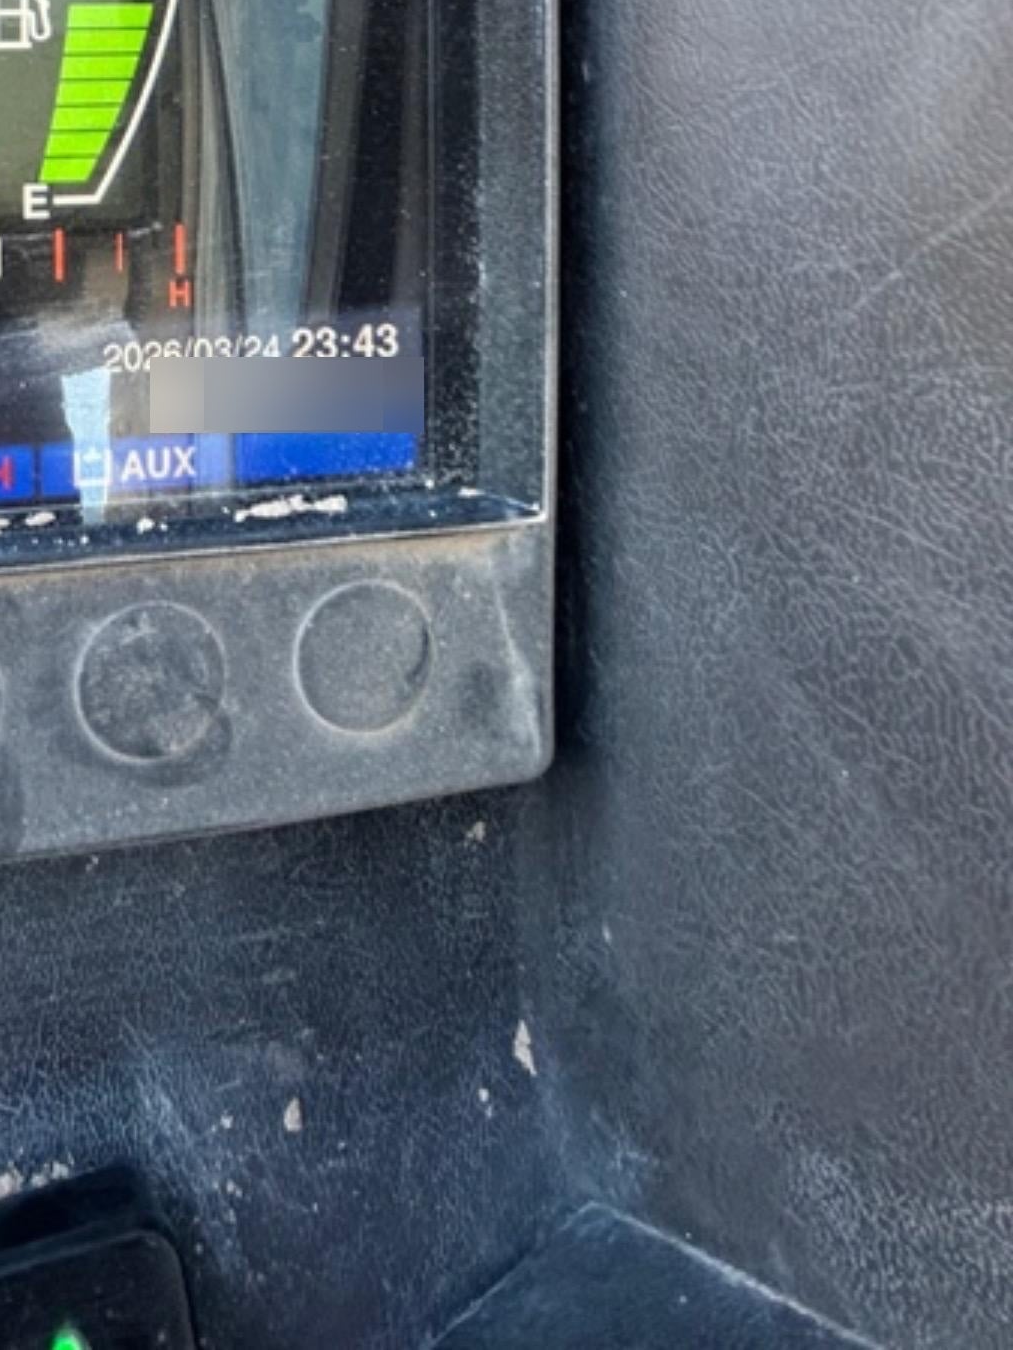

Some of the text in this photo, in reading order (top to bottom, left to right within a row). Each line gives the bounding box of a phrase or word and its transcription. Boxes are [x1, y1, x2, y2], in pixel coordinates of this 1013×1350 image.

[22, 184, 51, 219] E
[168, 279, 193, 307] H
[292, 323, 399, 358] 23:43
[120, 447, 197, 482] AUX
